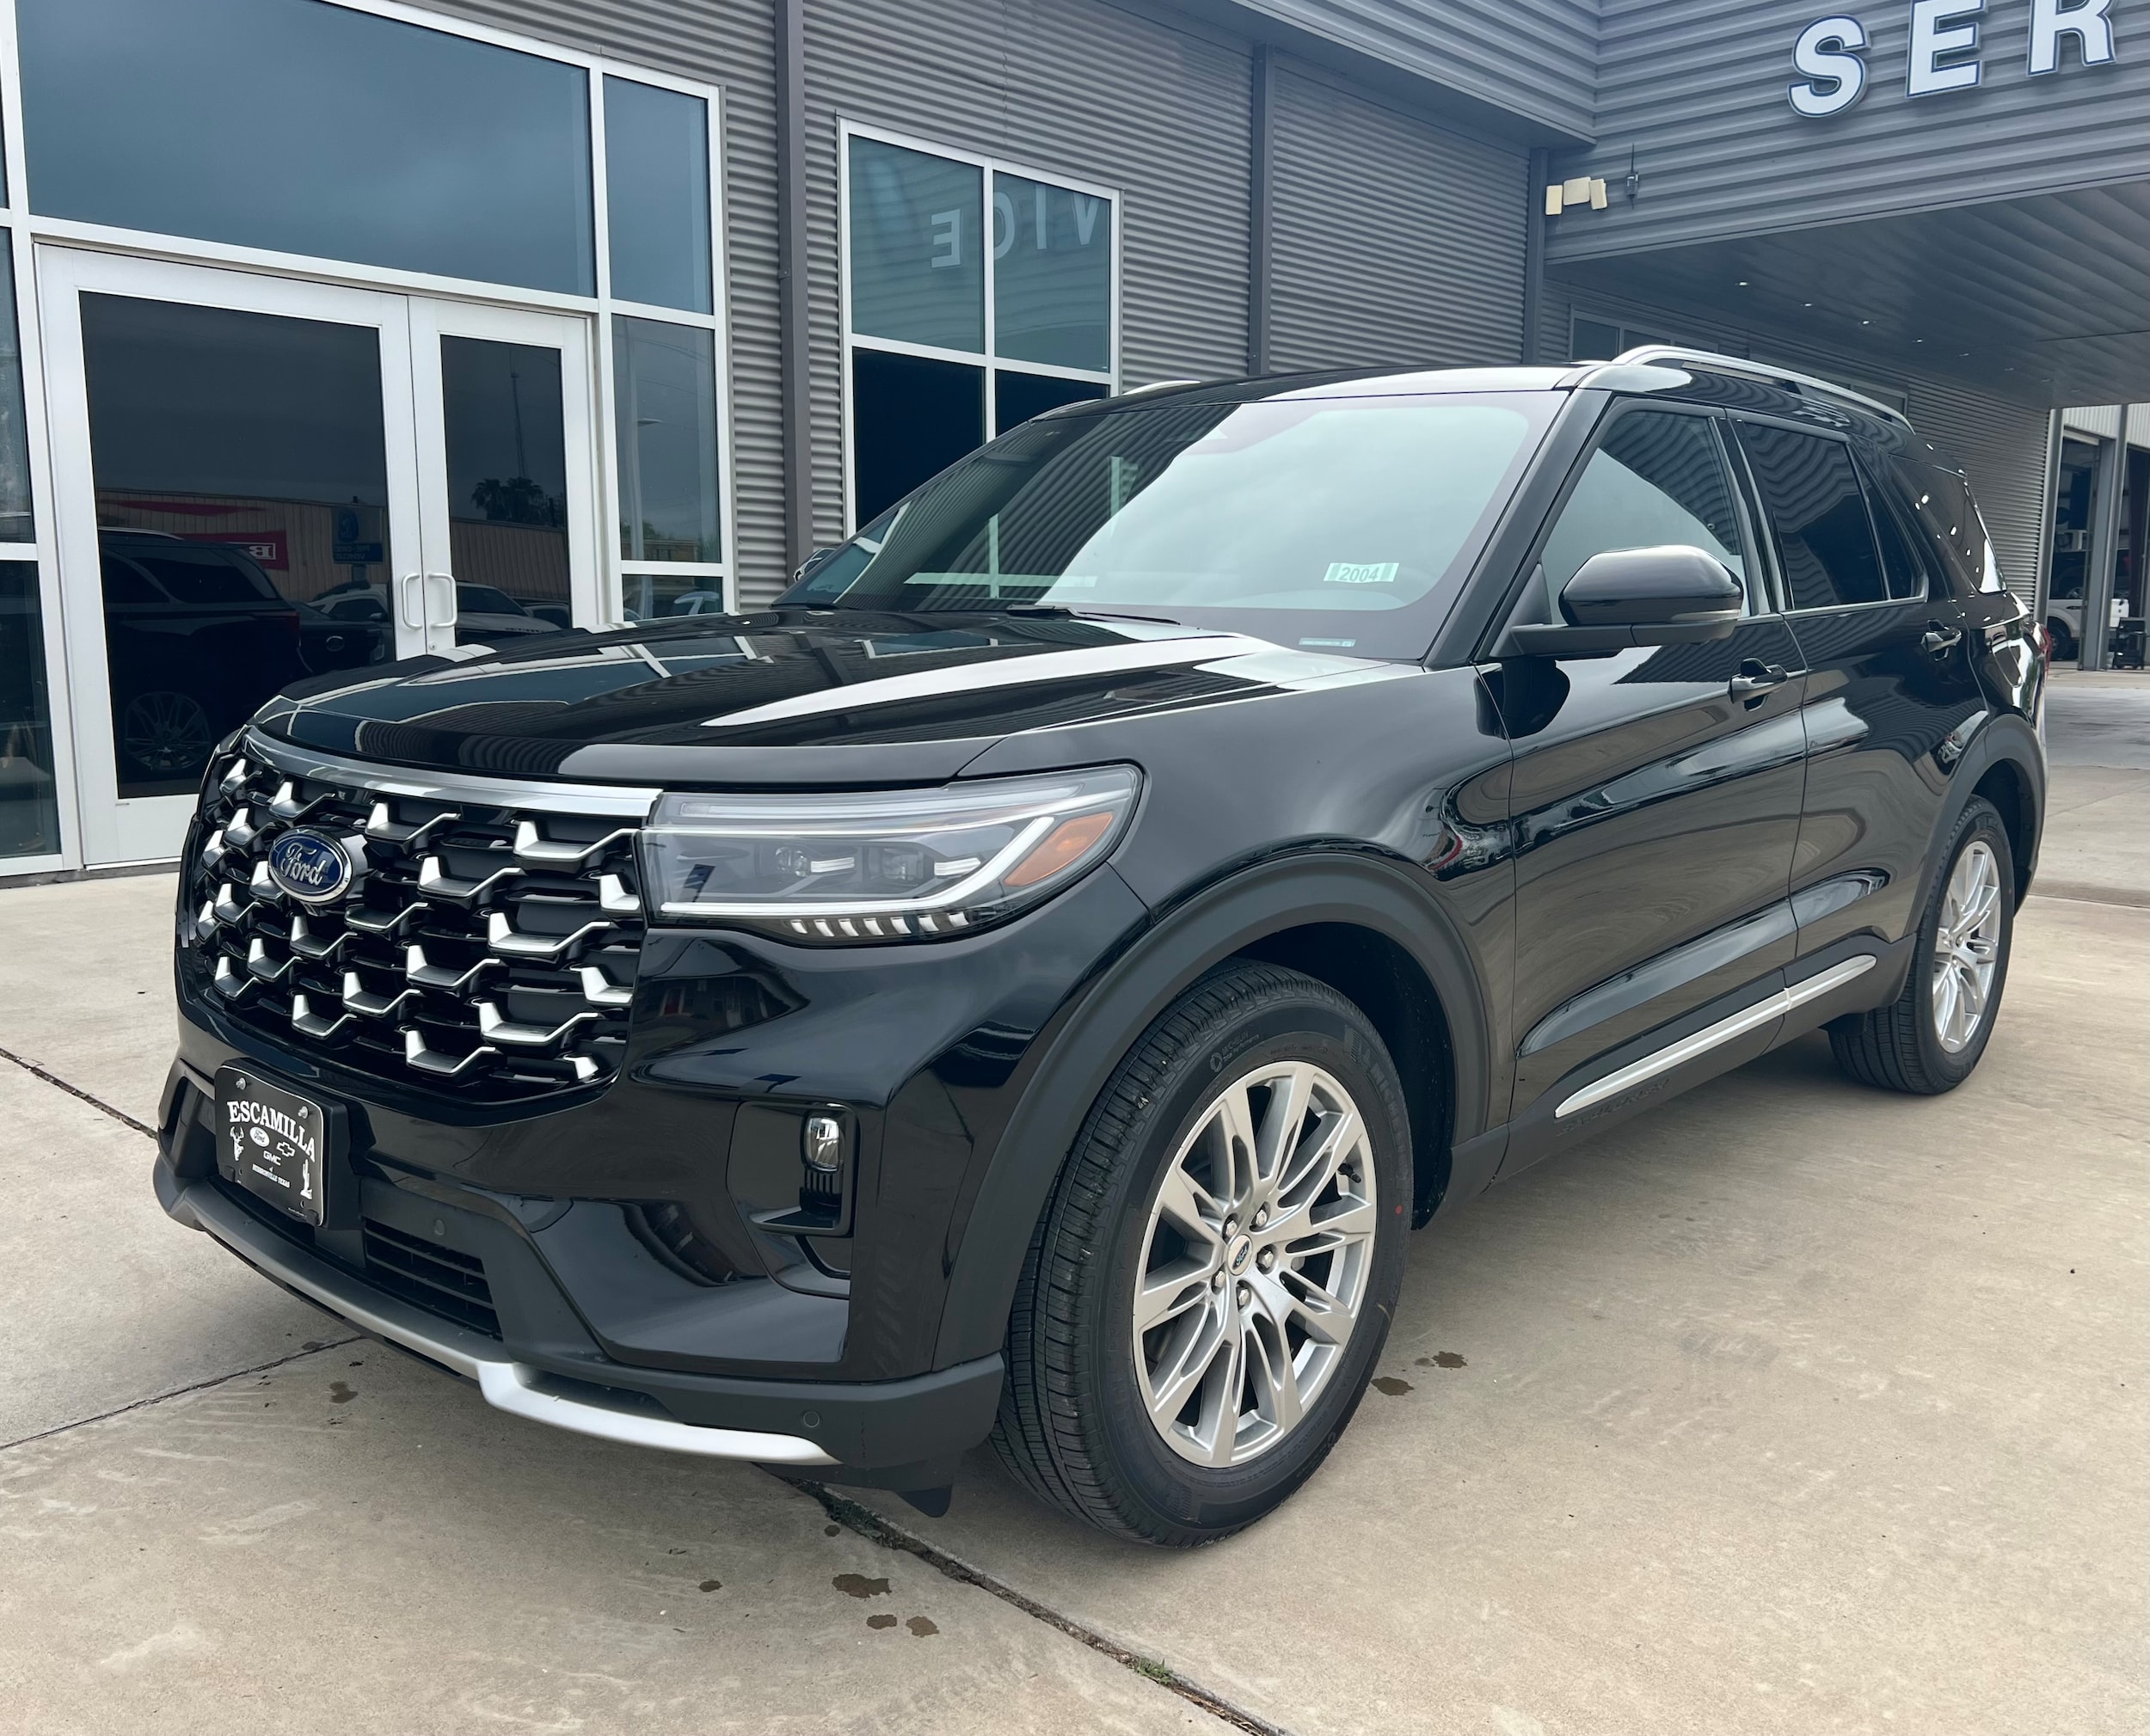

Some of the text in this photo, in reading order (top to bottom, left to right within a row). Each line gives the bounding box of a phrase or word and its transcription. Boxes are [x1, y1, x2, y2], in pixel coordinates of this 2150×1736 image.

[1788, 0, 2119, 118] SER
[1338, 566, 1379, 582] 2004
[280, 843, 327, 886] Ford
[226, 1101, 316, 1162] ESCAMILLA
[263, 1150, 281, 1166] GMC
